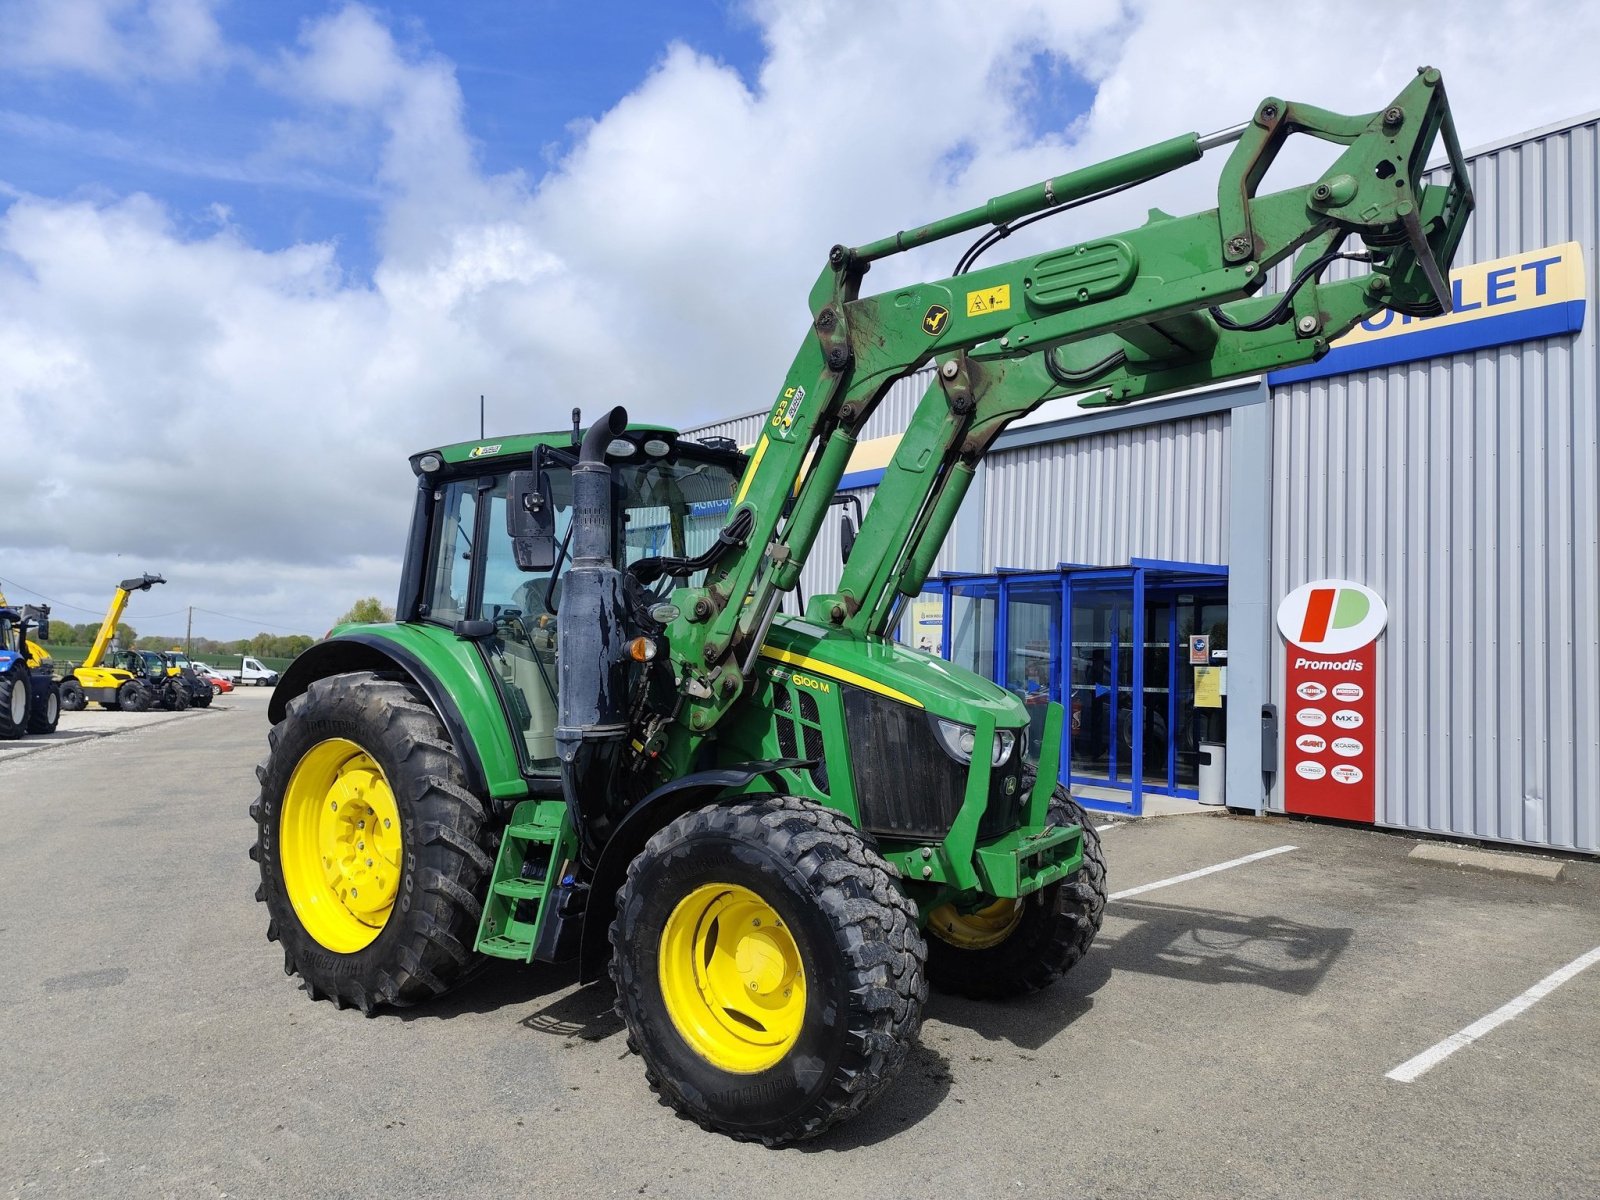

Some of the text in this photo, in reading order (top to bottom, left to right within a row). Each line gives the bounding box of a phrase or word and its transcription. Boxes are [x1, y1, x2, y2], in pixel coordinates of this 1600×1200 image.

[772, 387, 797, 427] 623 R
[1294, 657, 1364, 672] Promodis
[792, 674, 819, 689] 6100
[820, 682, 830, 694] M
